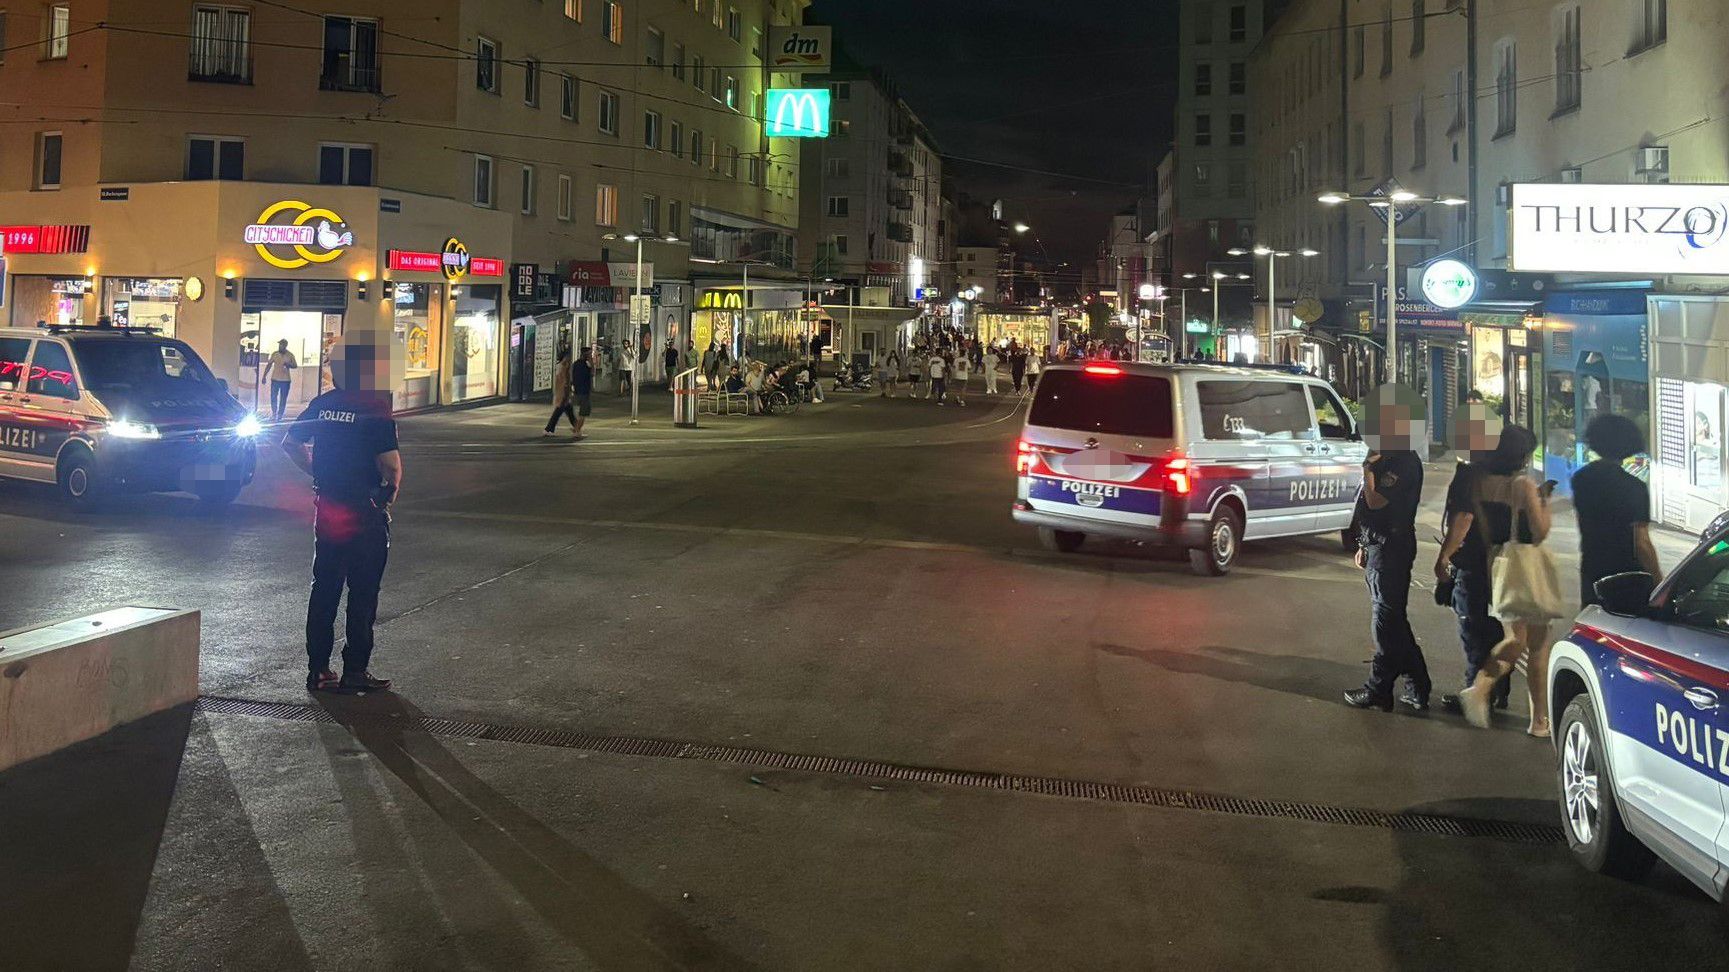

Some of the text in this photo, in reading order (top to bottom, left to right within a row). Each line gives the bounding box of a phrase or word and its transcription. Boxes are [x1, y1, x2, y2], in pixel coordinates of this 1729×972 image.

[783, 33, 818, 54] dm
[1521, 204, 1716, 234] THURZO
[8, 233, 34, 245] 1996
[401, 257, 412, 265] DAS
[413, 257, 439, 267] ORIGINAL
[572, 267, 589, 280] ria
[518, 286, 533, 297] LE
[318, 409, 356, 423] POLIZEI
[1061, 480, 1119, 498] POLIZEI
[1290, 479, 1339, 501] POLIZEI
